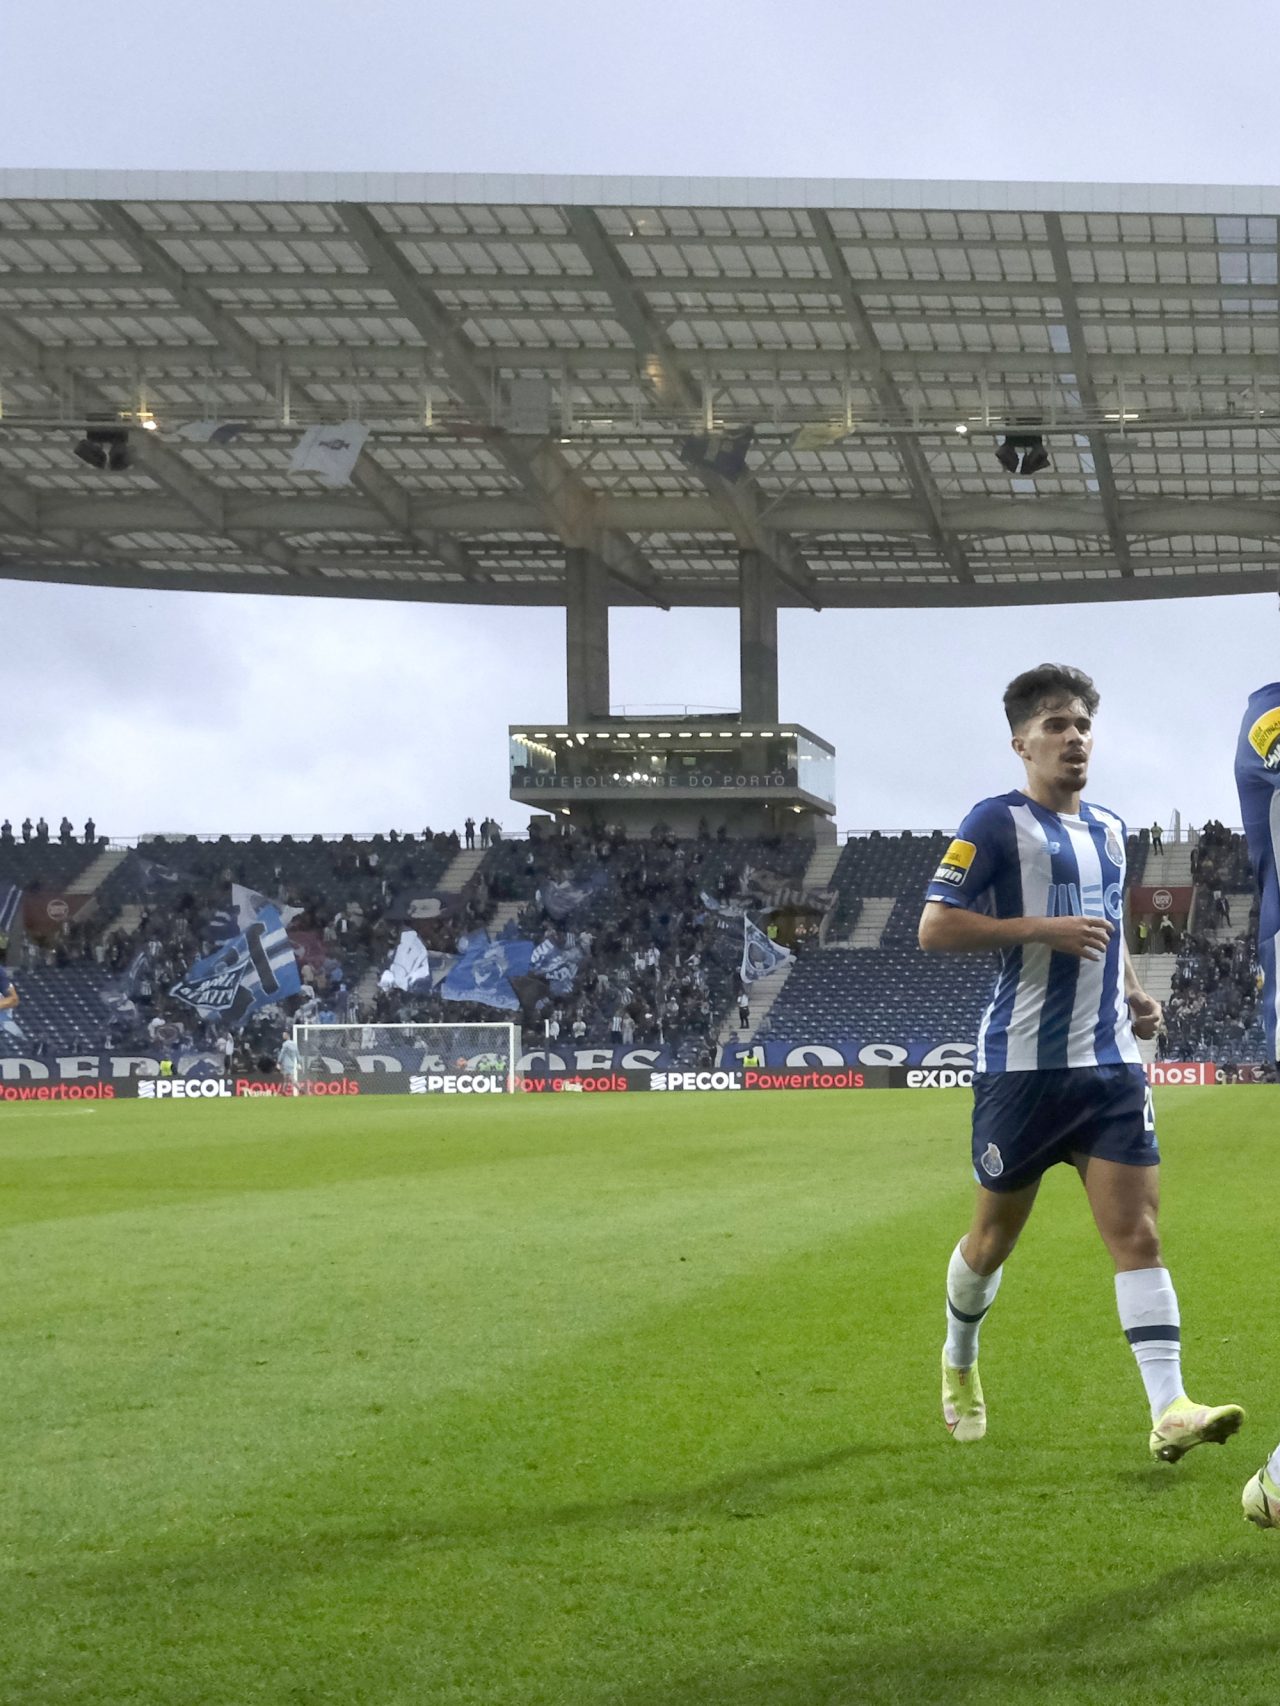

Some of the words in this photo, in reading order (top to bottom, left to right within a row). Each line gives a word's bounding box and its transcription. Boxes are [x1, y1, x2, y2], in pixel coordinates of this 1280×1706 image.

[523, 776, 608, 788] FUTEBOL
[689, 776, 712, 787] DO
[723, 775, 785, 786] PORTO
[156, 1079, 232, 1098] PECOL
[428, 1075, 502, 1093] PECOL
[668, 1071, 741, 1090] PECOL
[745, 1070, 864, 1089] Powertools
